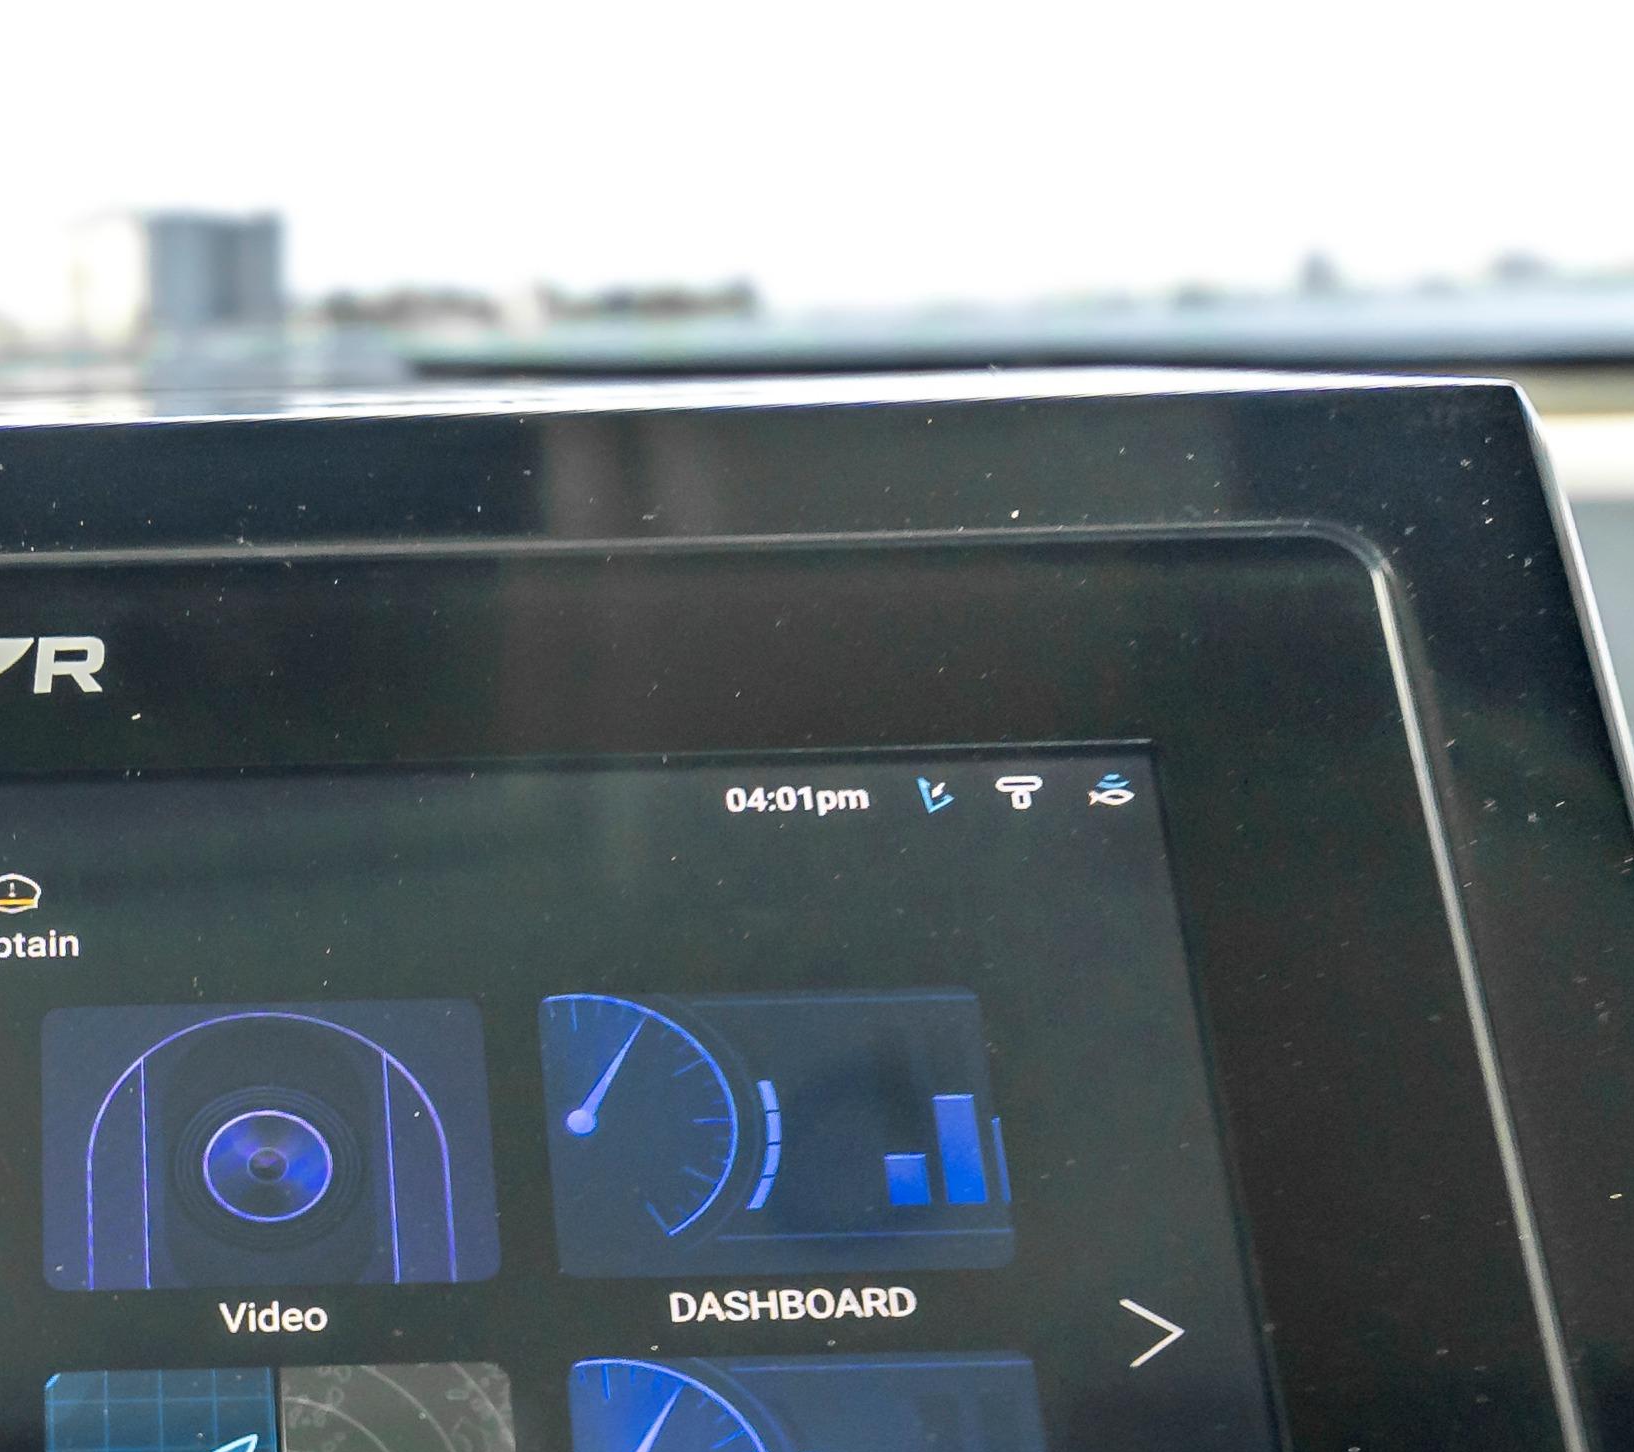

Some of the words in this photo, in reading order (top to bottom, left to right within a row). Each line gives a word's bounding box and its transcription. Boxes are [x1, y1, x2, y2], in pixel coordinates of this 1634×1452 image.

[725, 786, 870, 816] 04:01pm
[218, 1300, 329, 1334] Video
[668, 1286, 917, 1323] DASHBOARD
